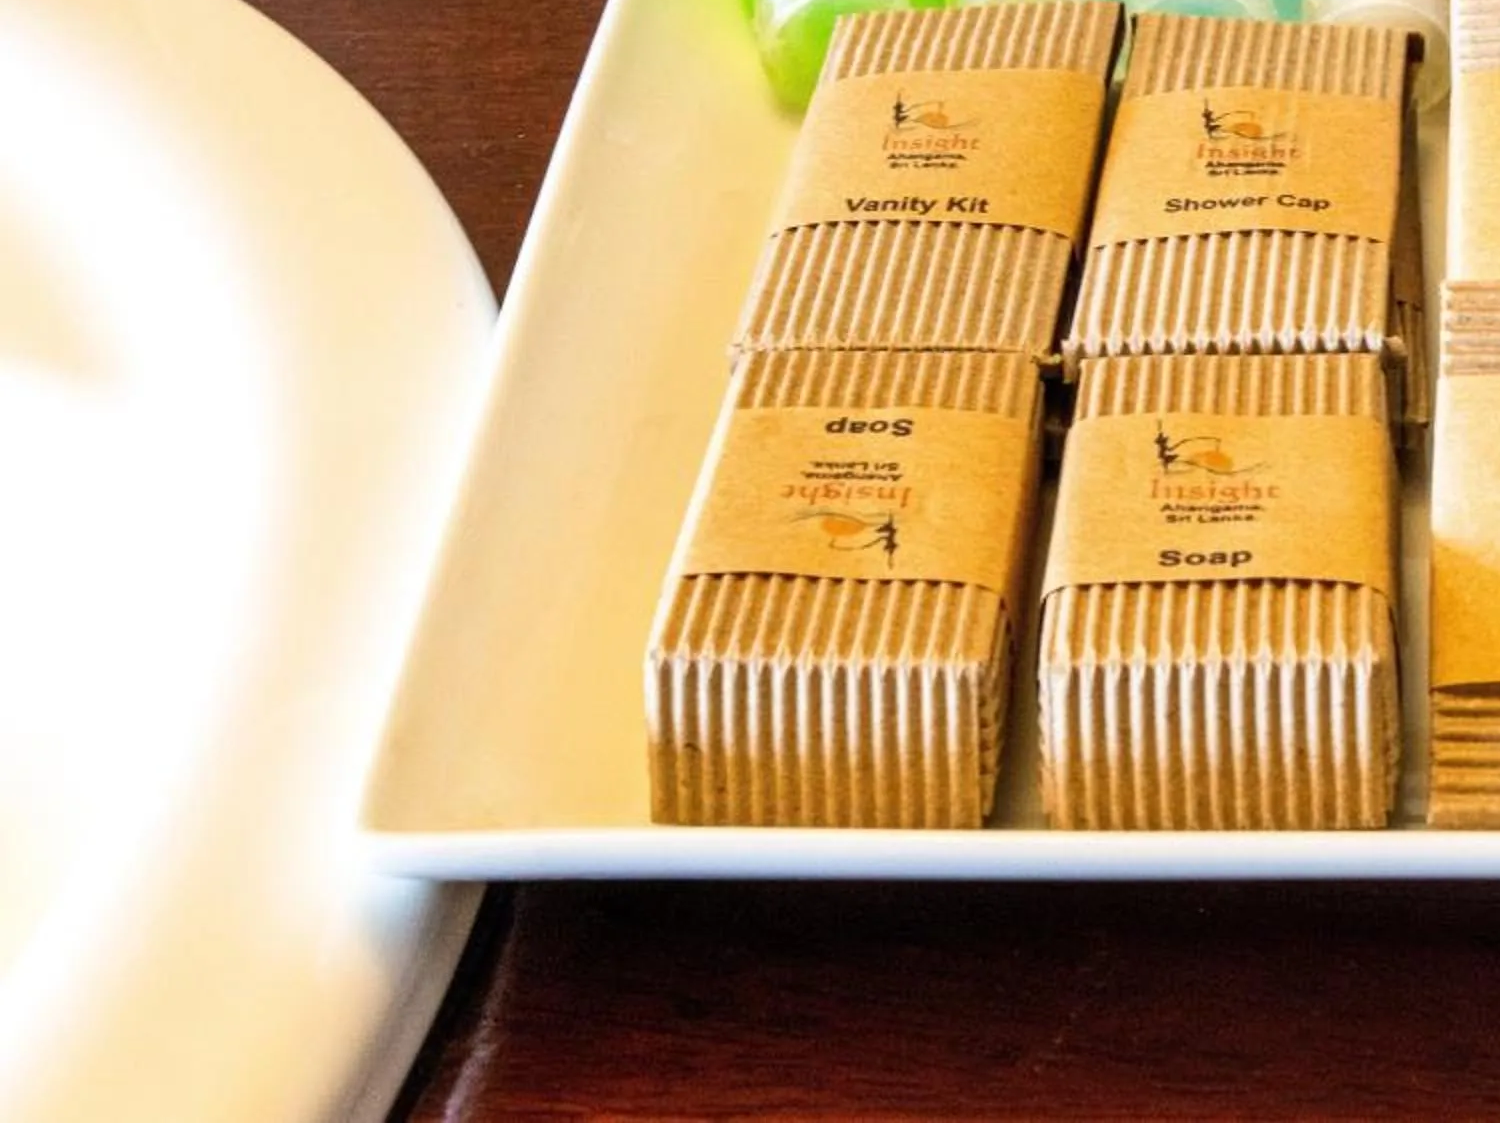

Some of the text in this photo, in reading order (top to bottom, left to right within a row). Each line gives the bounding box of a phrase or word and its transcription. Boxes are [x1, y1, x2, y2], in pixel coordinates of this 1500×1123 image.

[882, 133, 980, 152] Insight
[1196, 140, 1300, 160] Insight
[846, 197, 989, 215] Vanity Kit
[1164, 194, 1331, 213] Shower Cap
[825, 417, 914, 437] Soap
[780, 483, 912, 508] Insight
[1151, 479, 1280, 503] Insight
[1166, 514, 1192, 523] Sri
[1158, 550, 1253, 568] Soap
